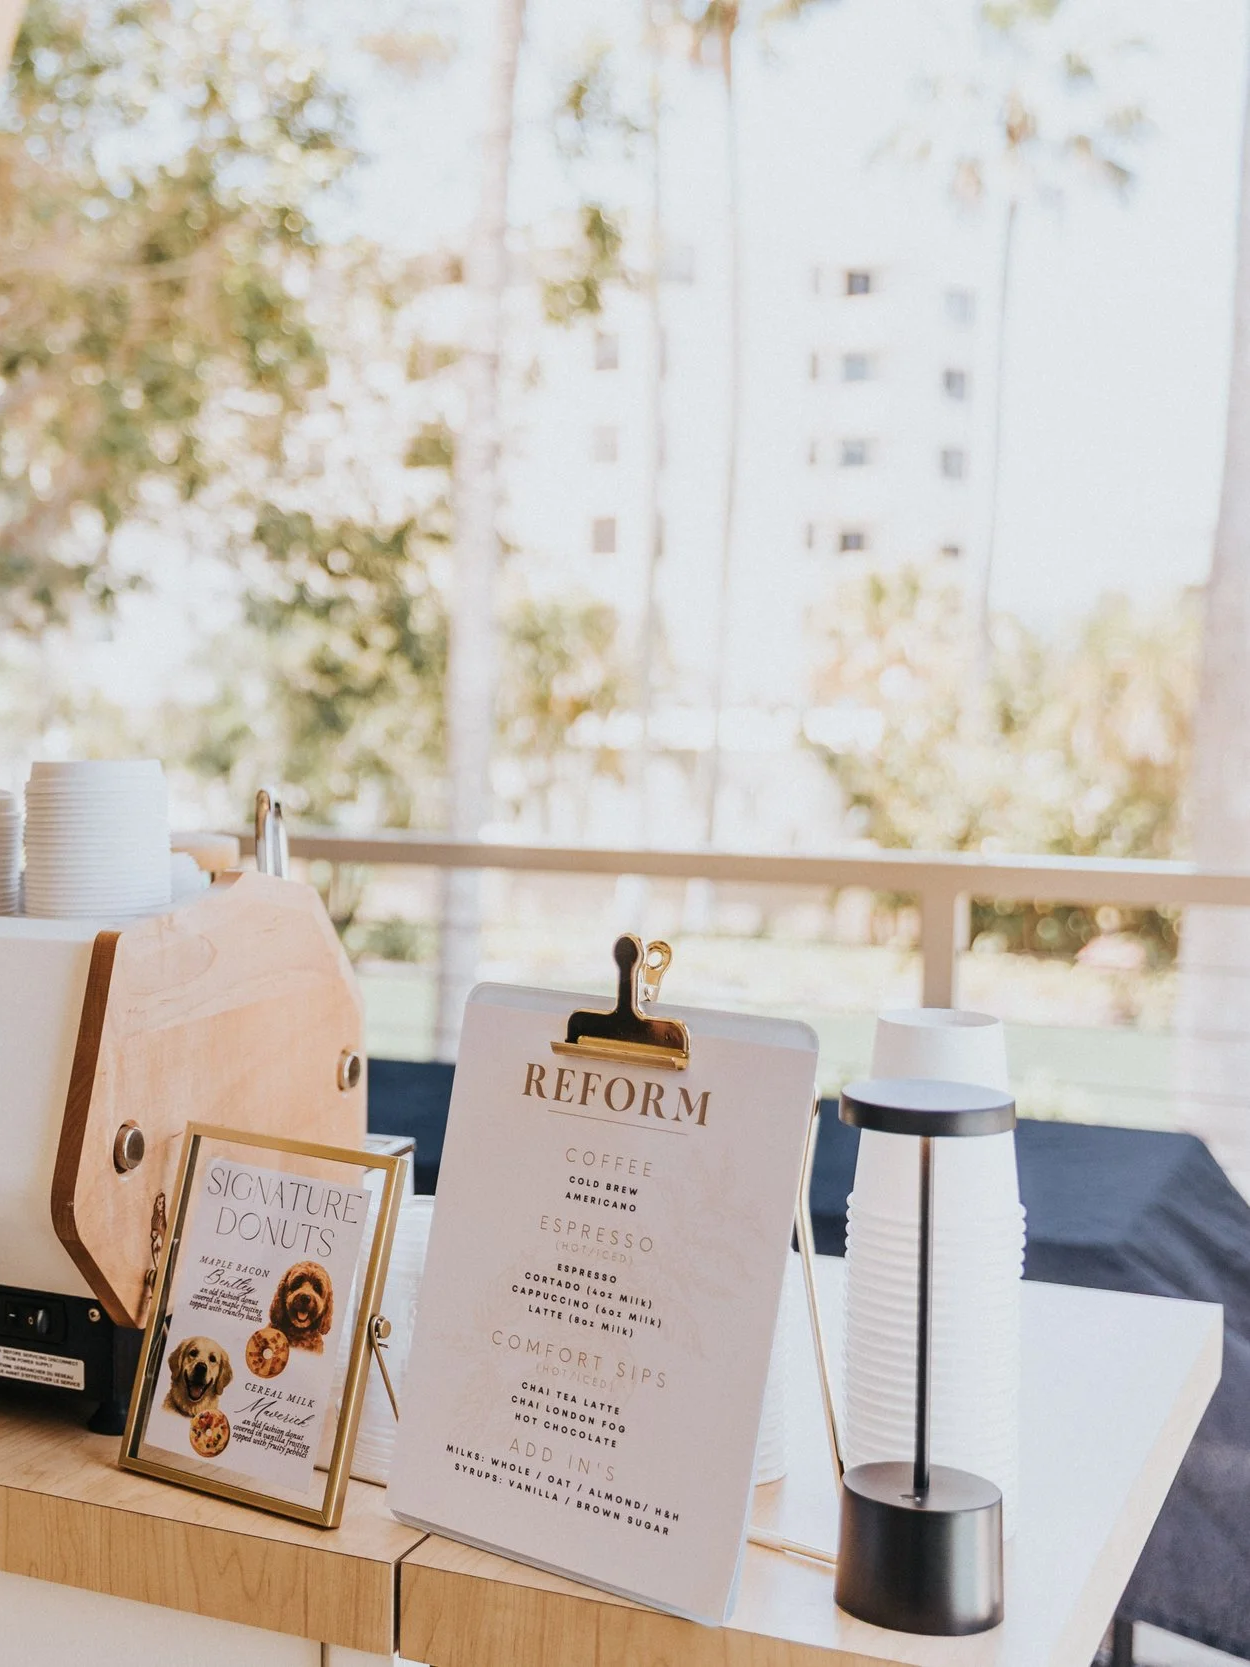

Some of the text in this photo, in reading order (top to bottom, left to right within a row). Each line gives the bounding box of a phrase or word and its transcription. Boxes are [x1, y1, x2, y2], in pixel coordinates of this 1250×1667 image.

[522, 1062, 711, 1126] REFORM
[565, 1148, 652, 1177] COFFEE
[207, 1167, 363, 1224] SIGNATURE
[565, 1191, 637, 1212] AMERICANO
[569, 1176, 638, 1196] COLD BREW
[215, 1206, 335, 1257] DONUTS
[540, 1215, 653, 1253] ESPRESSO
[199, 1255, 270, 1278] MAPLE BACON
[203, 1268, 256, 1297] Bentley
[557, 1263, 617, 1284] ESPRESSO
[190, 1299, 209, 1310] topped
[209, 1304, 222, 1313] with
[192, 1293, 214, 1303] covered
[221, 1299, 240, 1310] maple
[209, 1288, 219, 1296] old
[511, 1284, 662, 1329] CAPPUCCINO (6oz Milk)
[524, 1271, 652, 1310] CORTADO (4oz Milk)
[528, 1304, 633, 1338] LATTE (8oz Milk)
[492, 1330, 666, 1388] COMFORT SIPS
[244, 1382, 315, 1408] CEREAL MILK
[521, 1381, 620, 1416] CHAI TEA LATTE
[234, 1397, 315, 1427] Maverick
[251, 1420, 262, 1429] old
[511, 1395, 626, 1434] CHAI LONDON FOG
[232, 1424, 255, 1434] covered
[232, 1432, 253, 1443] topped
[253, 1437, 267, 1446] with
[514, 1412, 618, 1448] HOT CHOCOLATE
[509, 1438, 615, 1482] ADD IN'S
[446, 1444, 485, 1462] MILKS:
[491, 1457, 530, 1476] WHOLE
[547, 1475, 571, 1489] OAT
[588, 1487, 648, 1512] ALMOND/
[654, 1507, 679, 1522] H&H
[454, 1462, 503, 1484] SYRUPS:
[509, 1479, 559, 1501] VANILLA
[576, 1500, 621, 1520] BROWN
[627, 1515, 670, 1536] SUGAR
